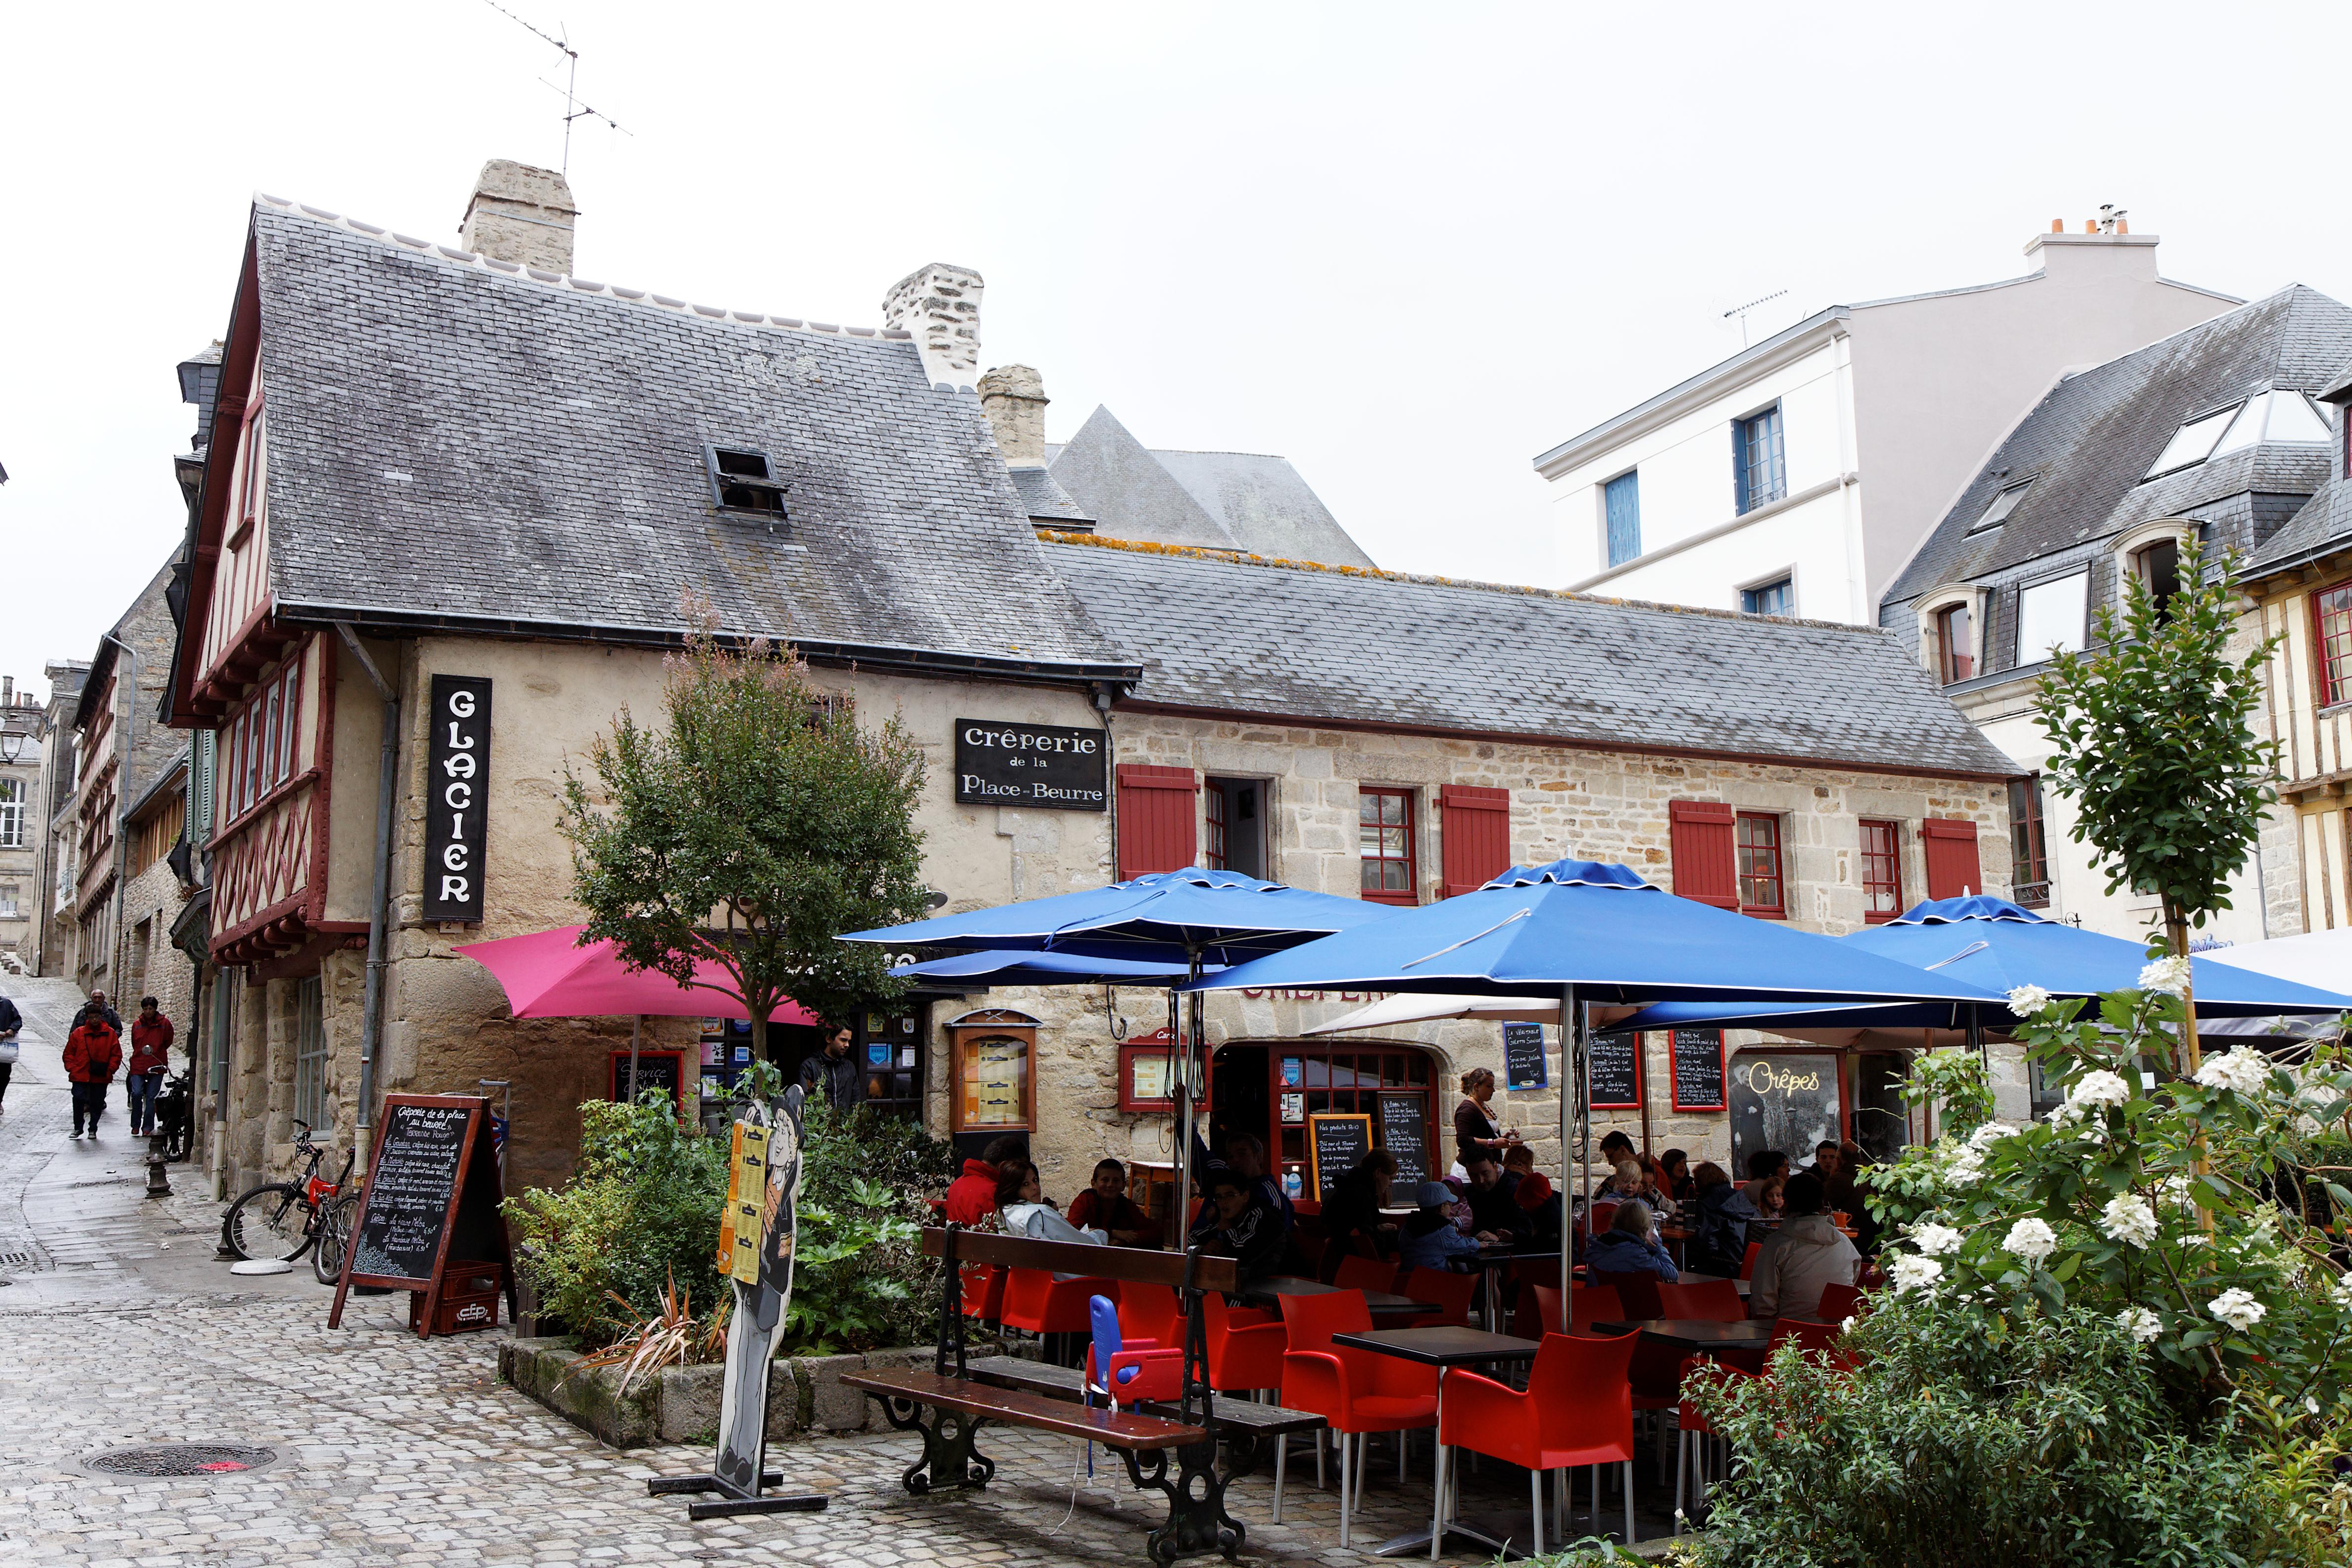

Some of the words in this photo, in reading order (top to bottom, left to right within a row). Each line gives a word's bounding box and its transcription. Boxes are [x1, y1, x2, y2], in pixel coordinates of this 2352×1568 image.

[1010, 757, 1026, 767] de
[1033, 757, 1047, 767] la
[962, 774, 1021, 796] Place
[1032, 783, 1103, 801] Beurre
[439, 690, 476, 903] GLACIER
[621, 1064, 667, 1078] Srvice
[1749, 1062, 1819, 1097] Crêpes
[398, 1107, 426, 1122] Crêperie
[427, 1109, 436, 1119] de
[437, 1110, 445, 1119] la
[445, 1110, 466, 1124] place
[422, 1118, 446, 1130] beurre
[1329, 1124, 1346, 1133] produits
